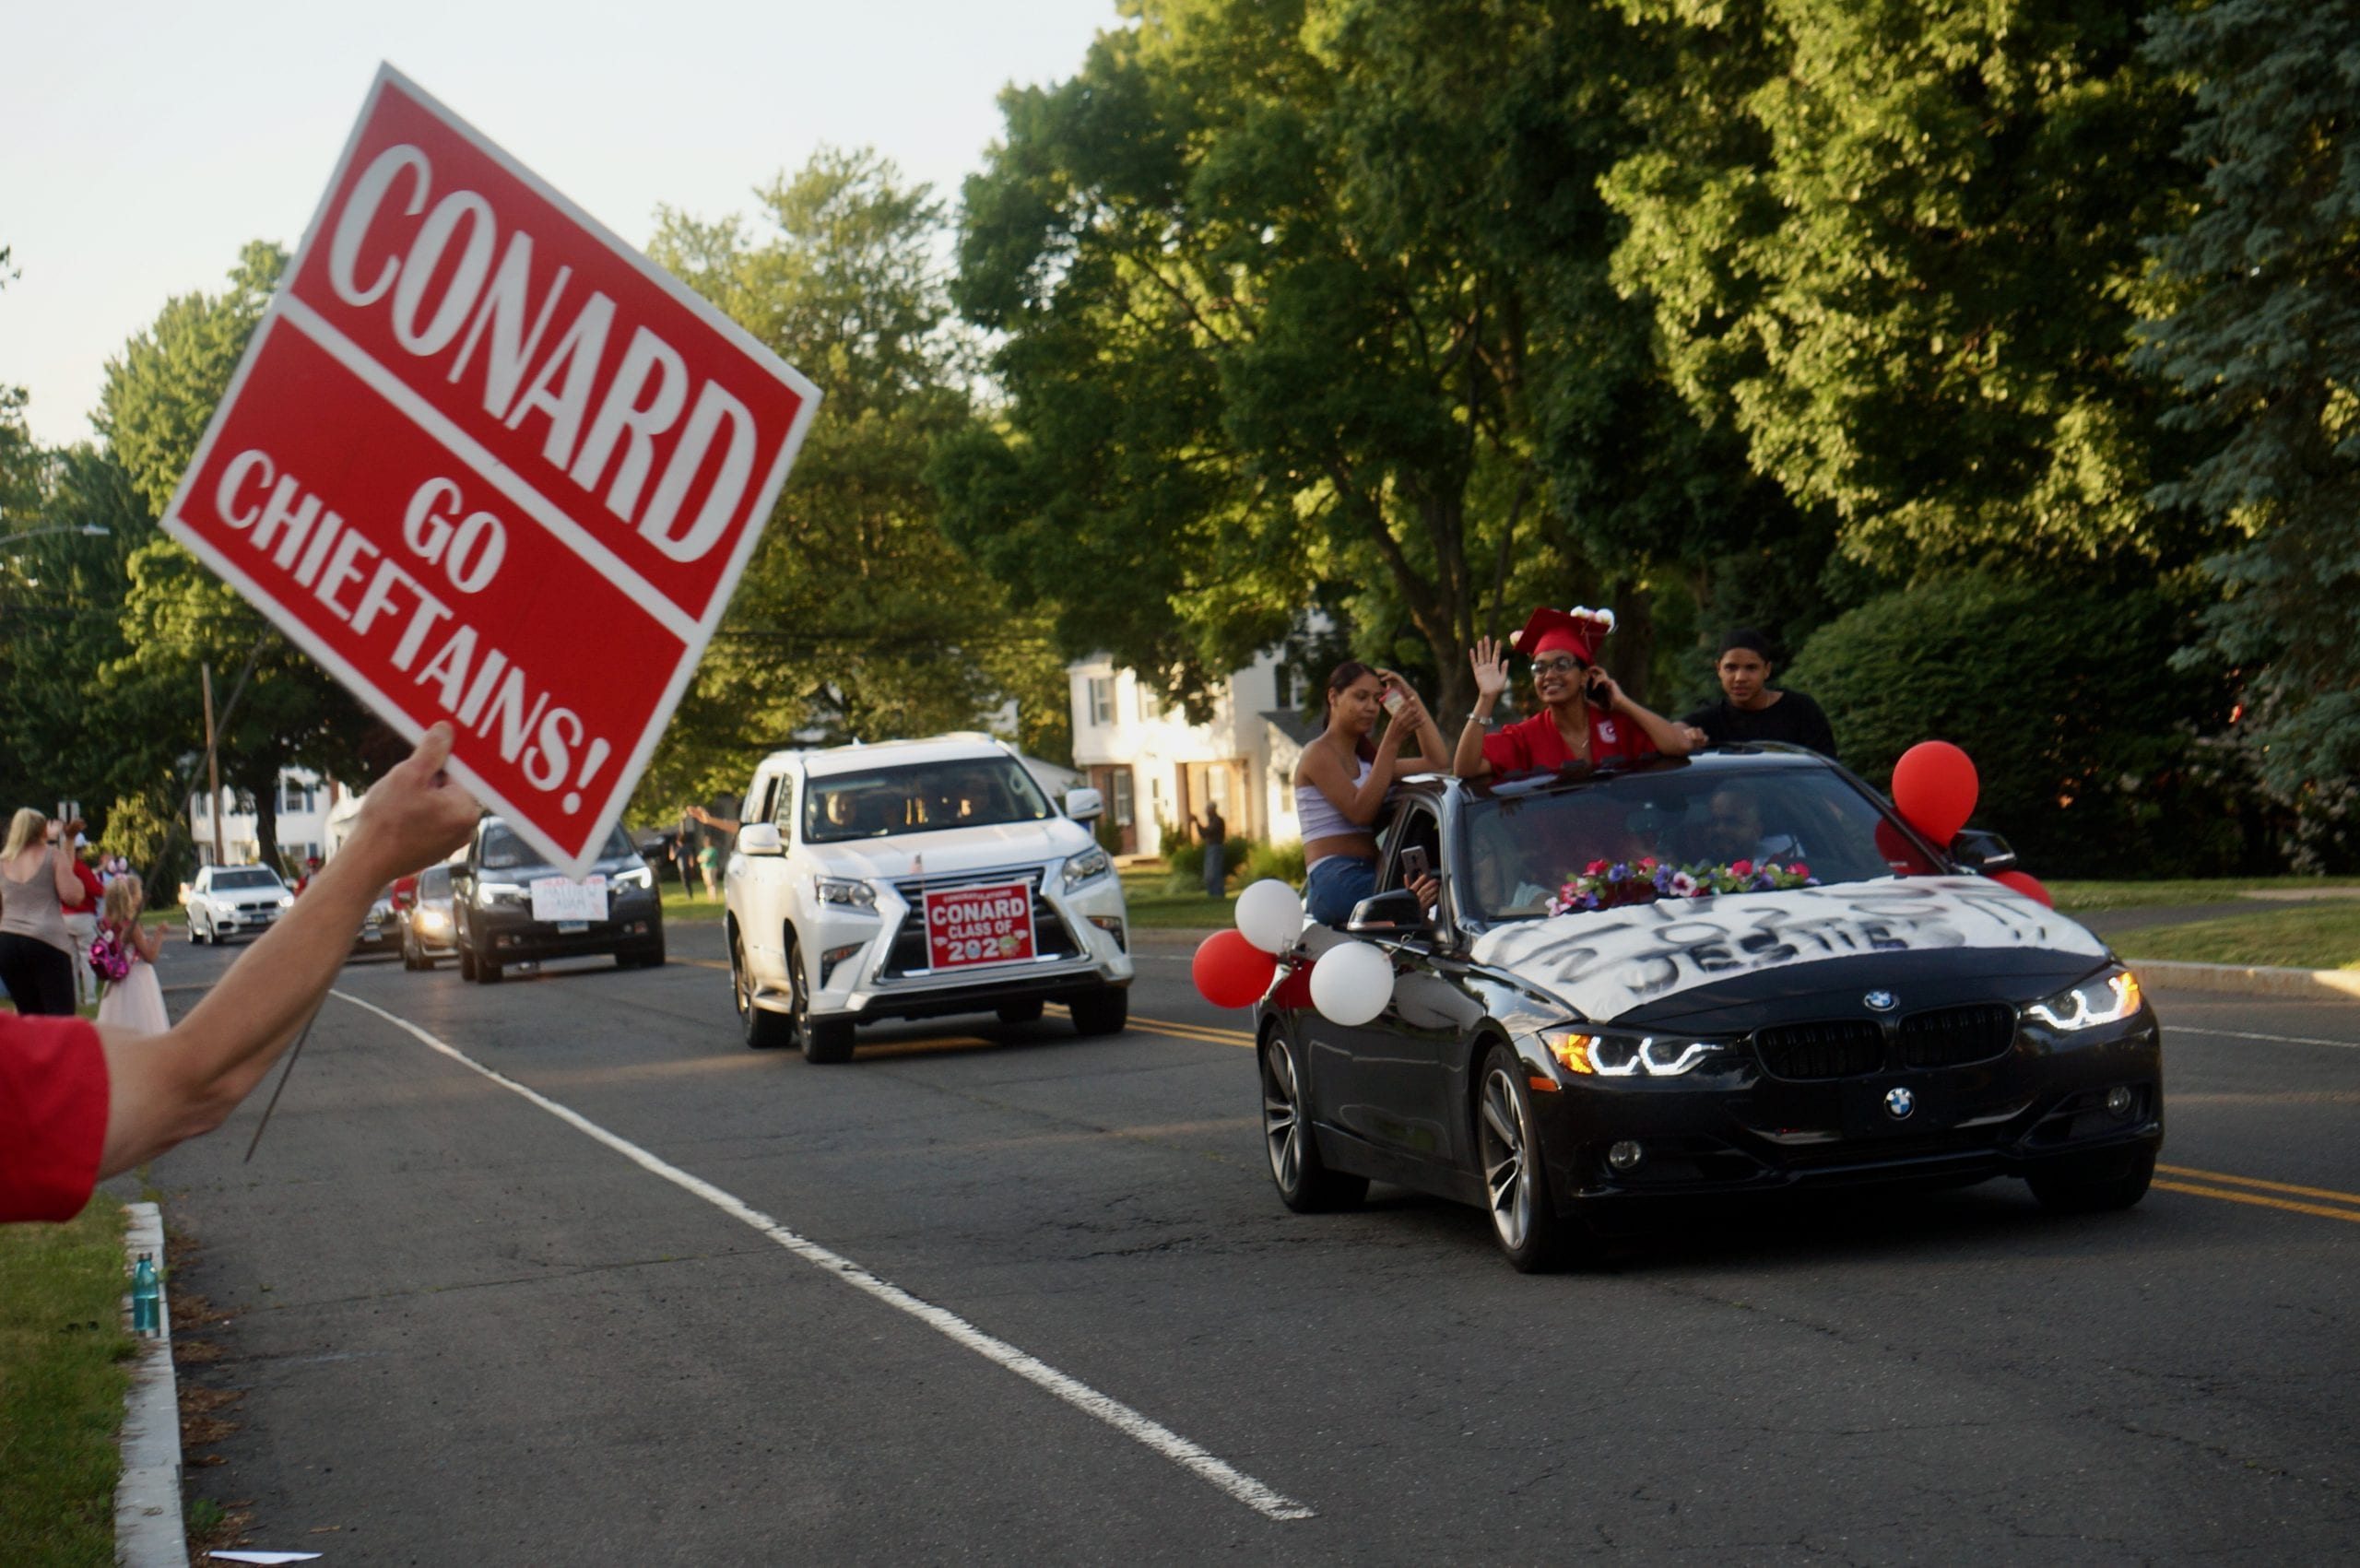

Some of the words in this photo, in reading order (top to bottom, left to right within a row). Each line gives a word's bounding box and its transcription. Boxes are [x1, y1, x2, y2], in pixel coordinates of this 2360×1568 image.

[328, 144, 758, 562] CONARD
[403, 477, 507, 592] GO
[215, 450, 611, 814] CHIEFTAINS!
[932, 898, 1025, 925] CONARD
[948, 924, 992, 939] CLASS
[995, 919, 1013, 935] OF
